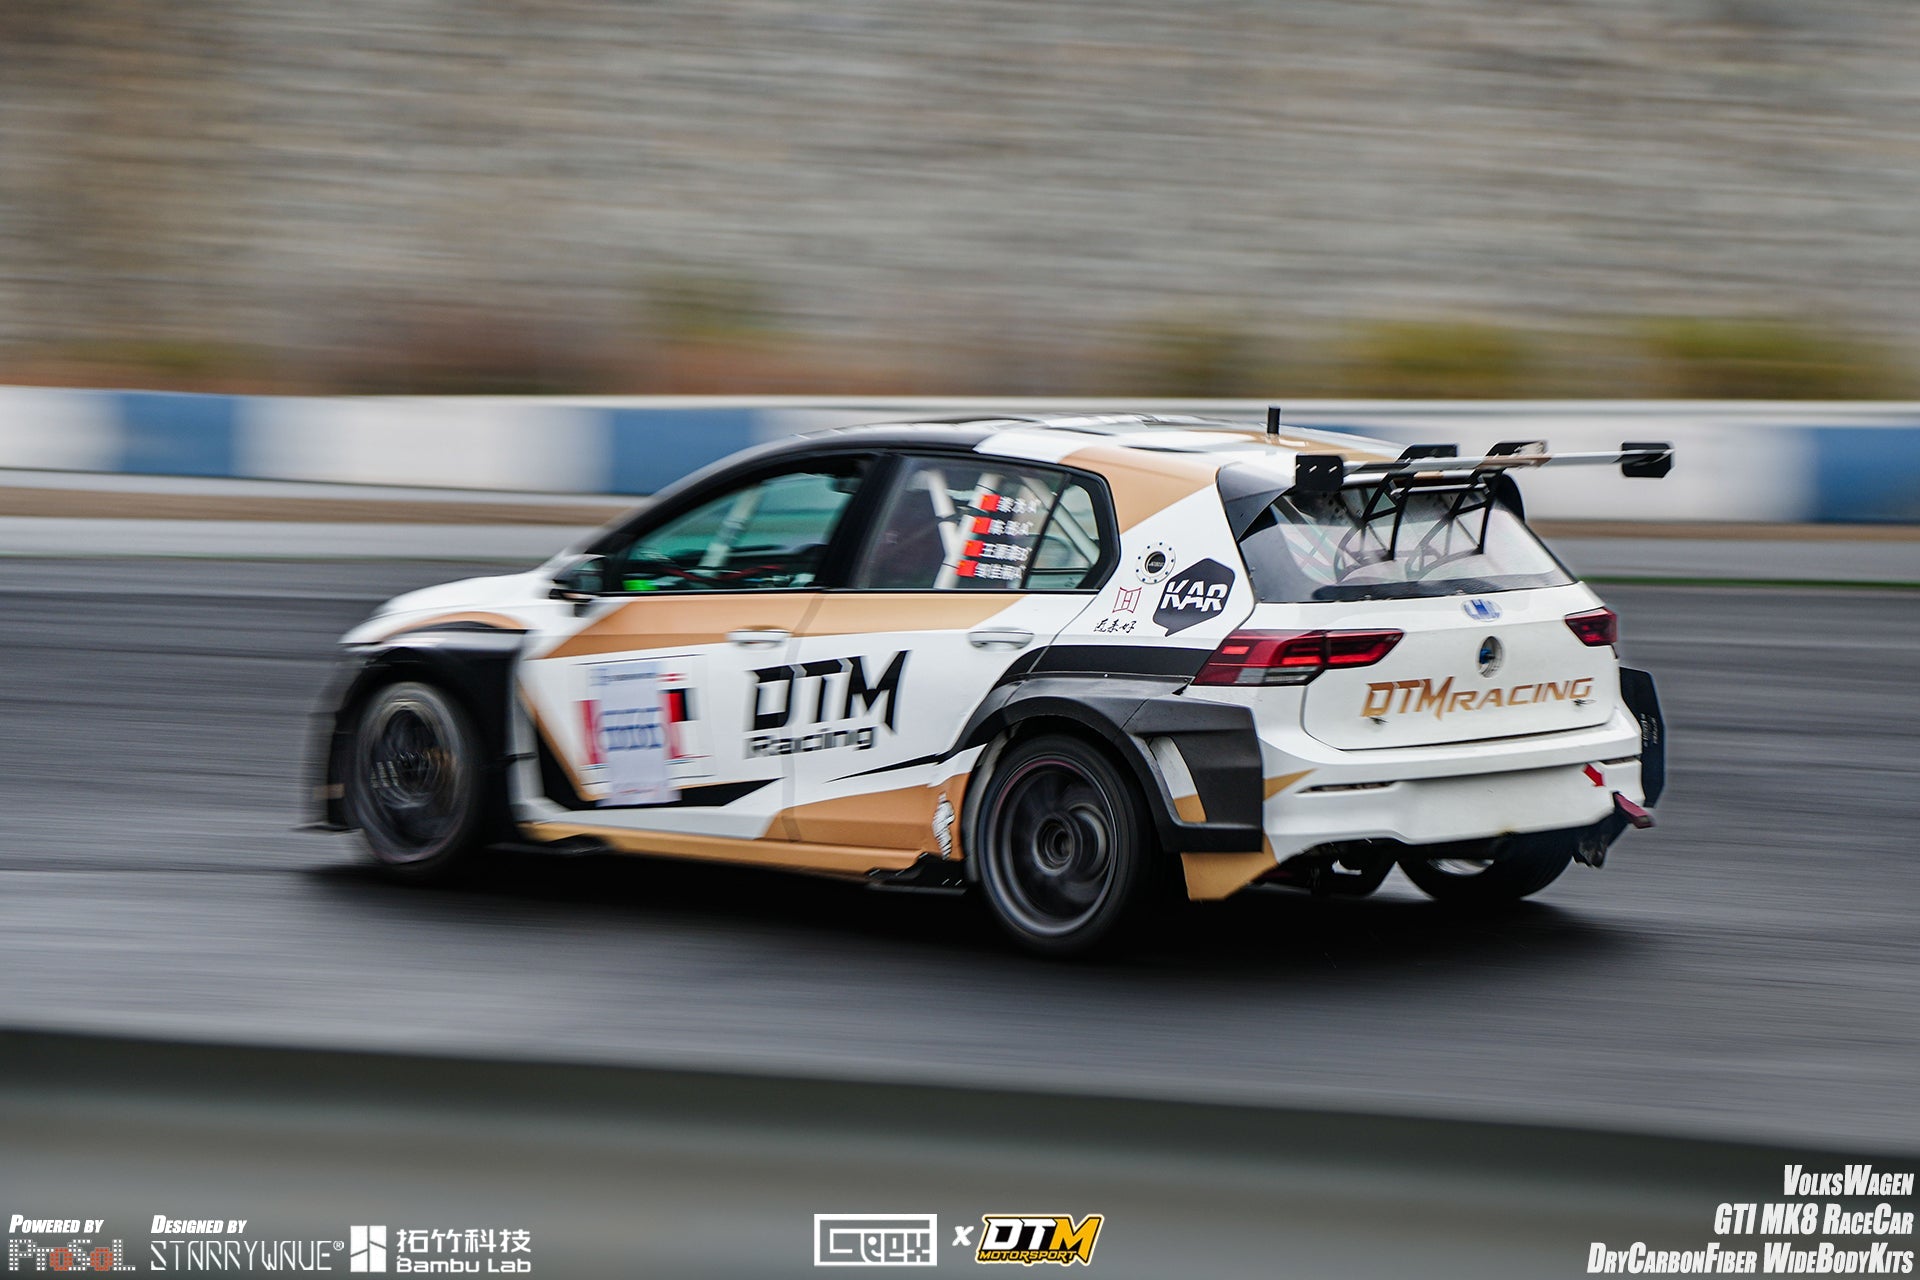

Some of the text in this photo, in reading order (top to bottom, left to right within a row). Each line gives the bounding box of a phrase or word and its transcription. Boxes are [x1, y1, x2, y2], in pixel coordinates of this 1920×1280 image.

[1160, 580, 1228, 613] KAR
[745, 650, 911, 735] DTM
[1361, 676, 1594, 720] DTM RACING
[745, 727, 875, 759] Racing
